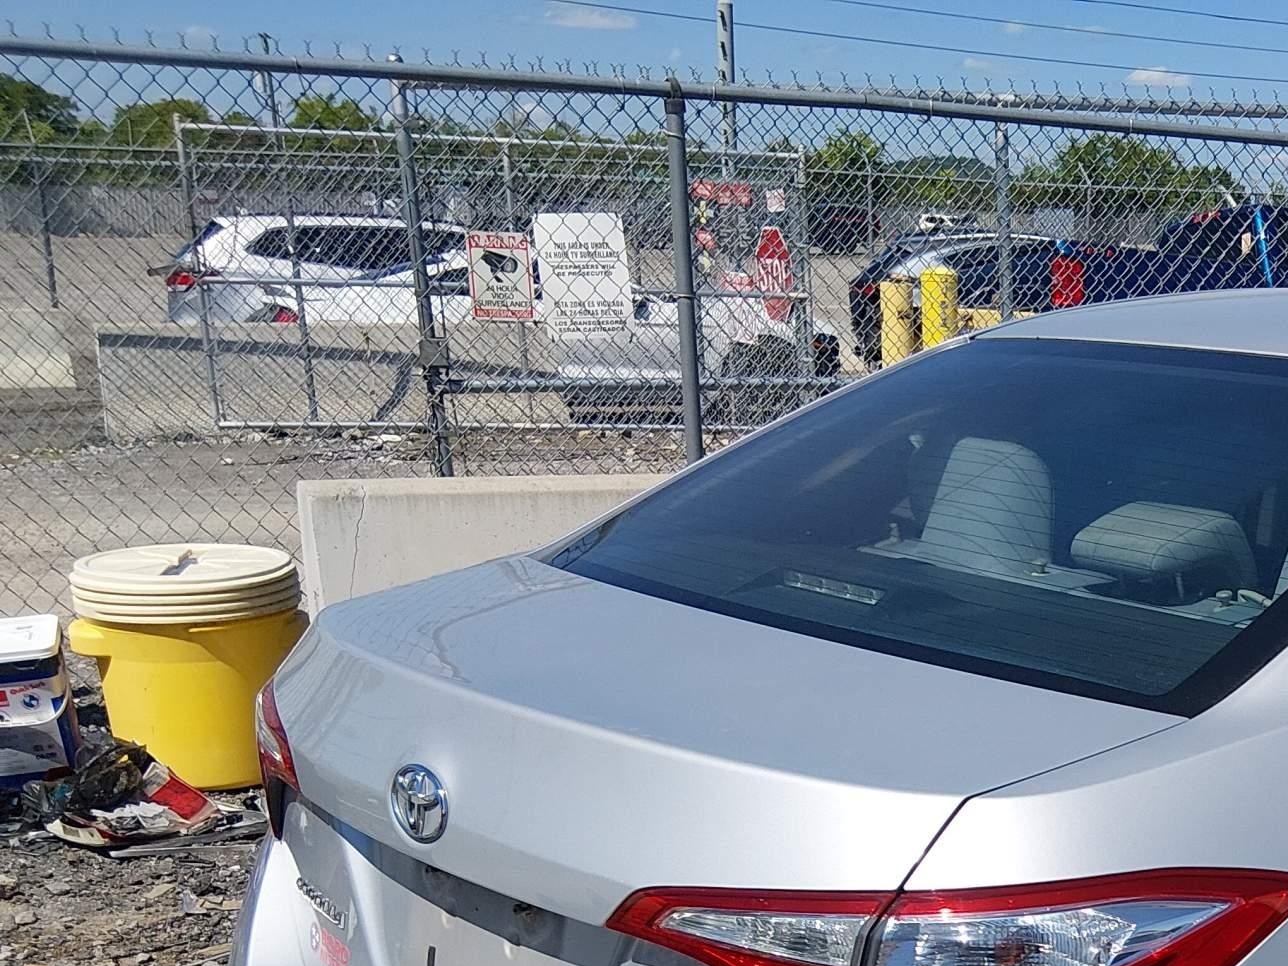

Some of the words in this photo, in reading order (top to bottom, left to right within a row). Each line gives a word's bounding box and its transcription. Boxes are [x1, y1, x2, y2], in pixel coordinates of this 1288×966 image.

[470, 235, 528, 250] WARNING
[570, 251, 578, 259] TV
[491, 292, 515, 301] VIDEO
